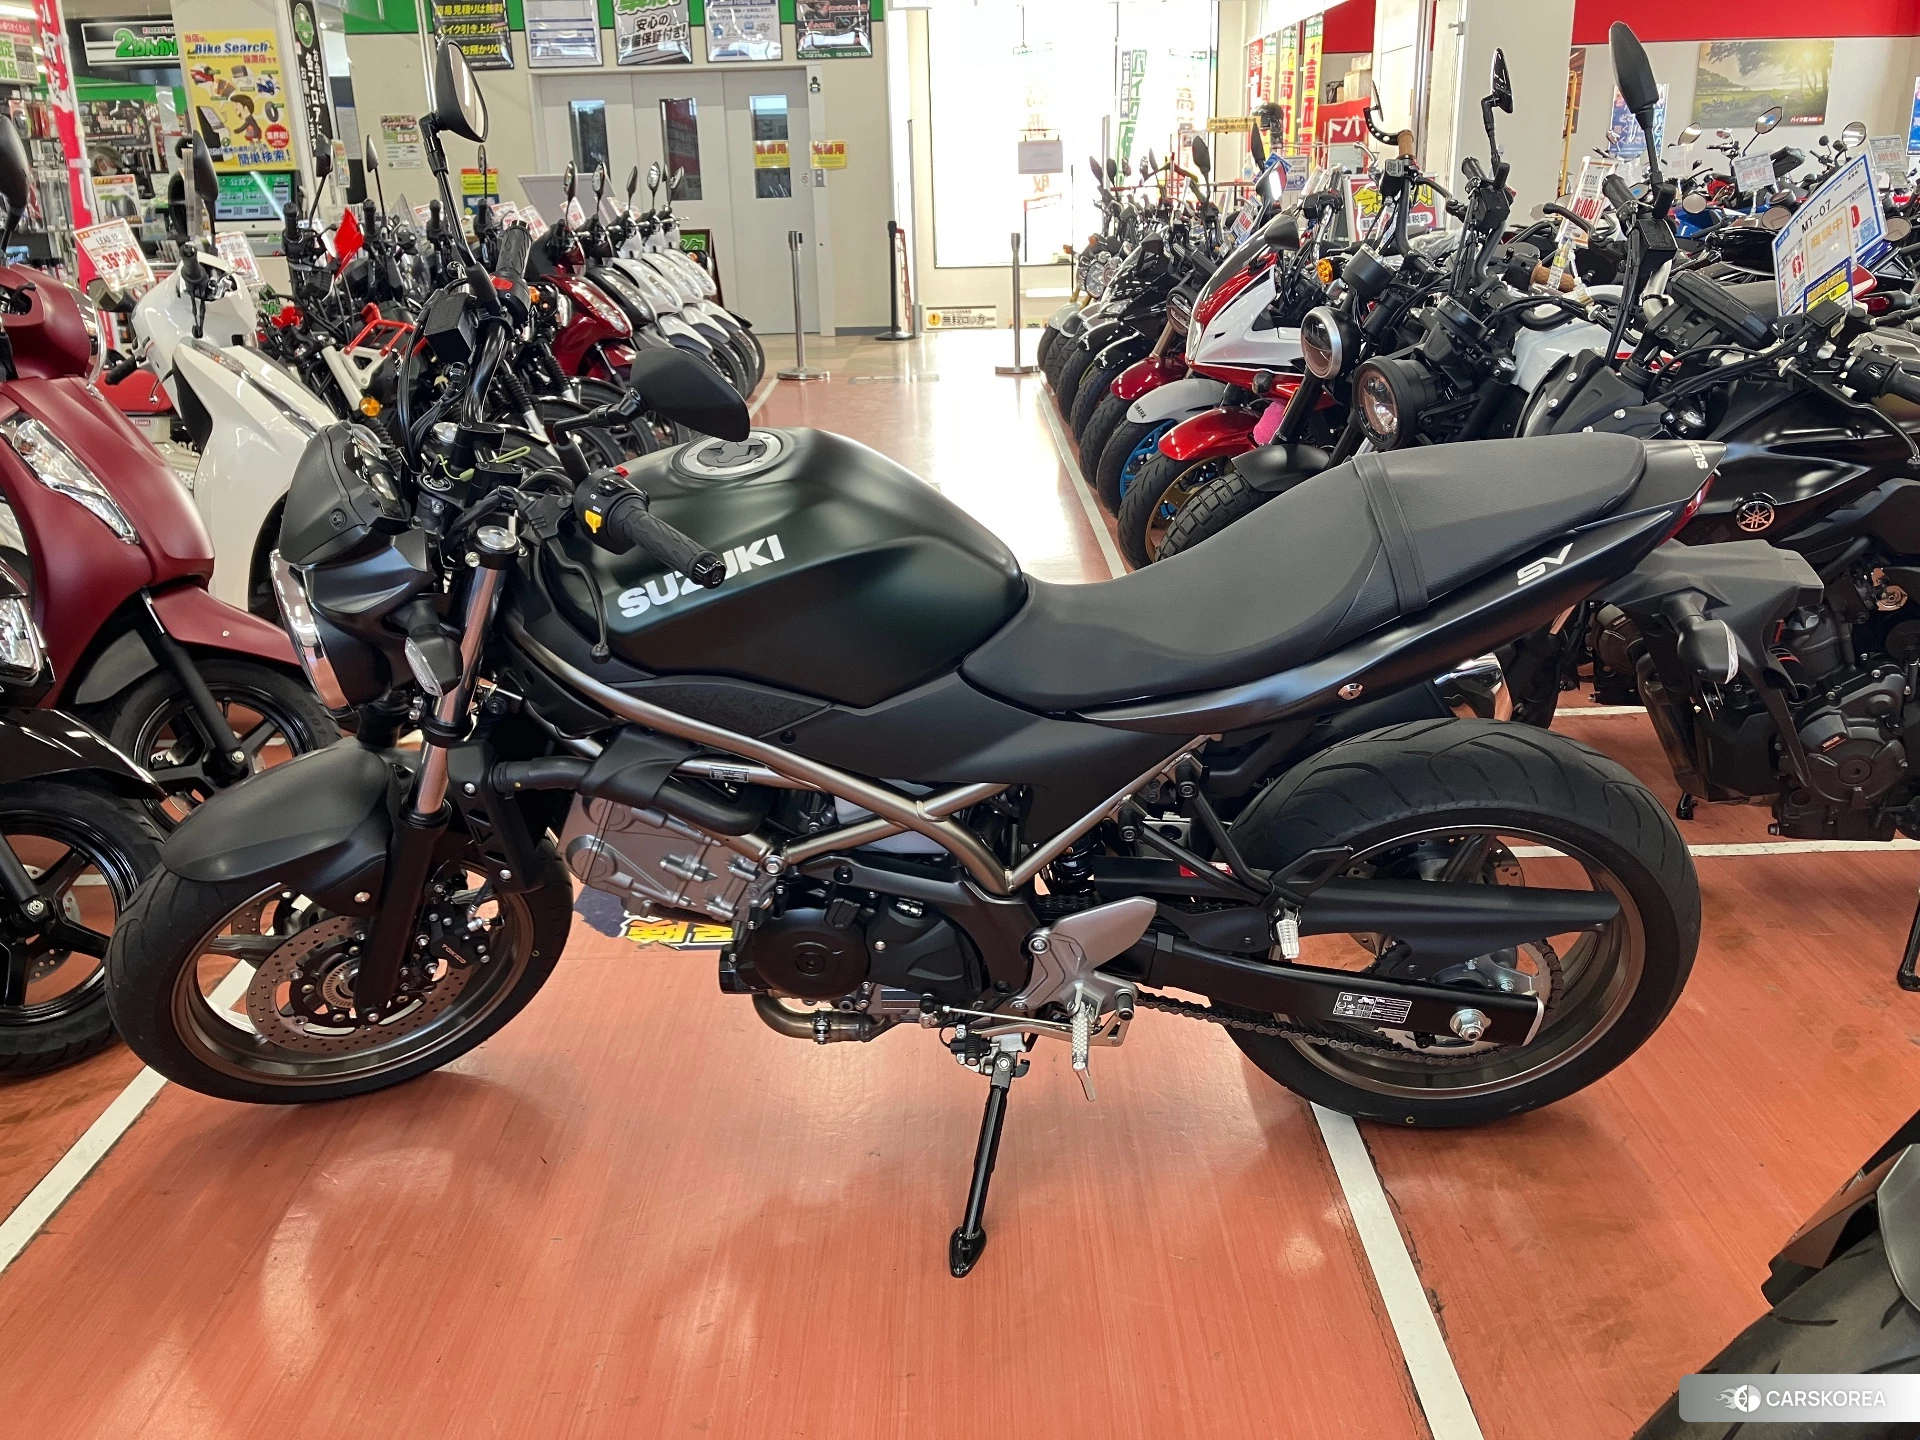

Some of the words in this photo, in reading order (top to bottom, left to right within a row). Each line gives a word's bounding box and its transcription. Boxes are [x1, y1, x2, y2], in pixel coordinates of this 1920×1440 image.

[636, 15, 669, 31] 安心の
[195, 44, 221, 54] Bike
[224, 42, 268, 53] Search
[305, 52, 324, 138] 各フロアに
[238, 149, 290, 166] 簡単検索!
[1801, 199, 1832, 234] MT-07
[942, 314, 995, 327] 無料ロッカー
[1517, 542, 1574, 586] SV
